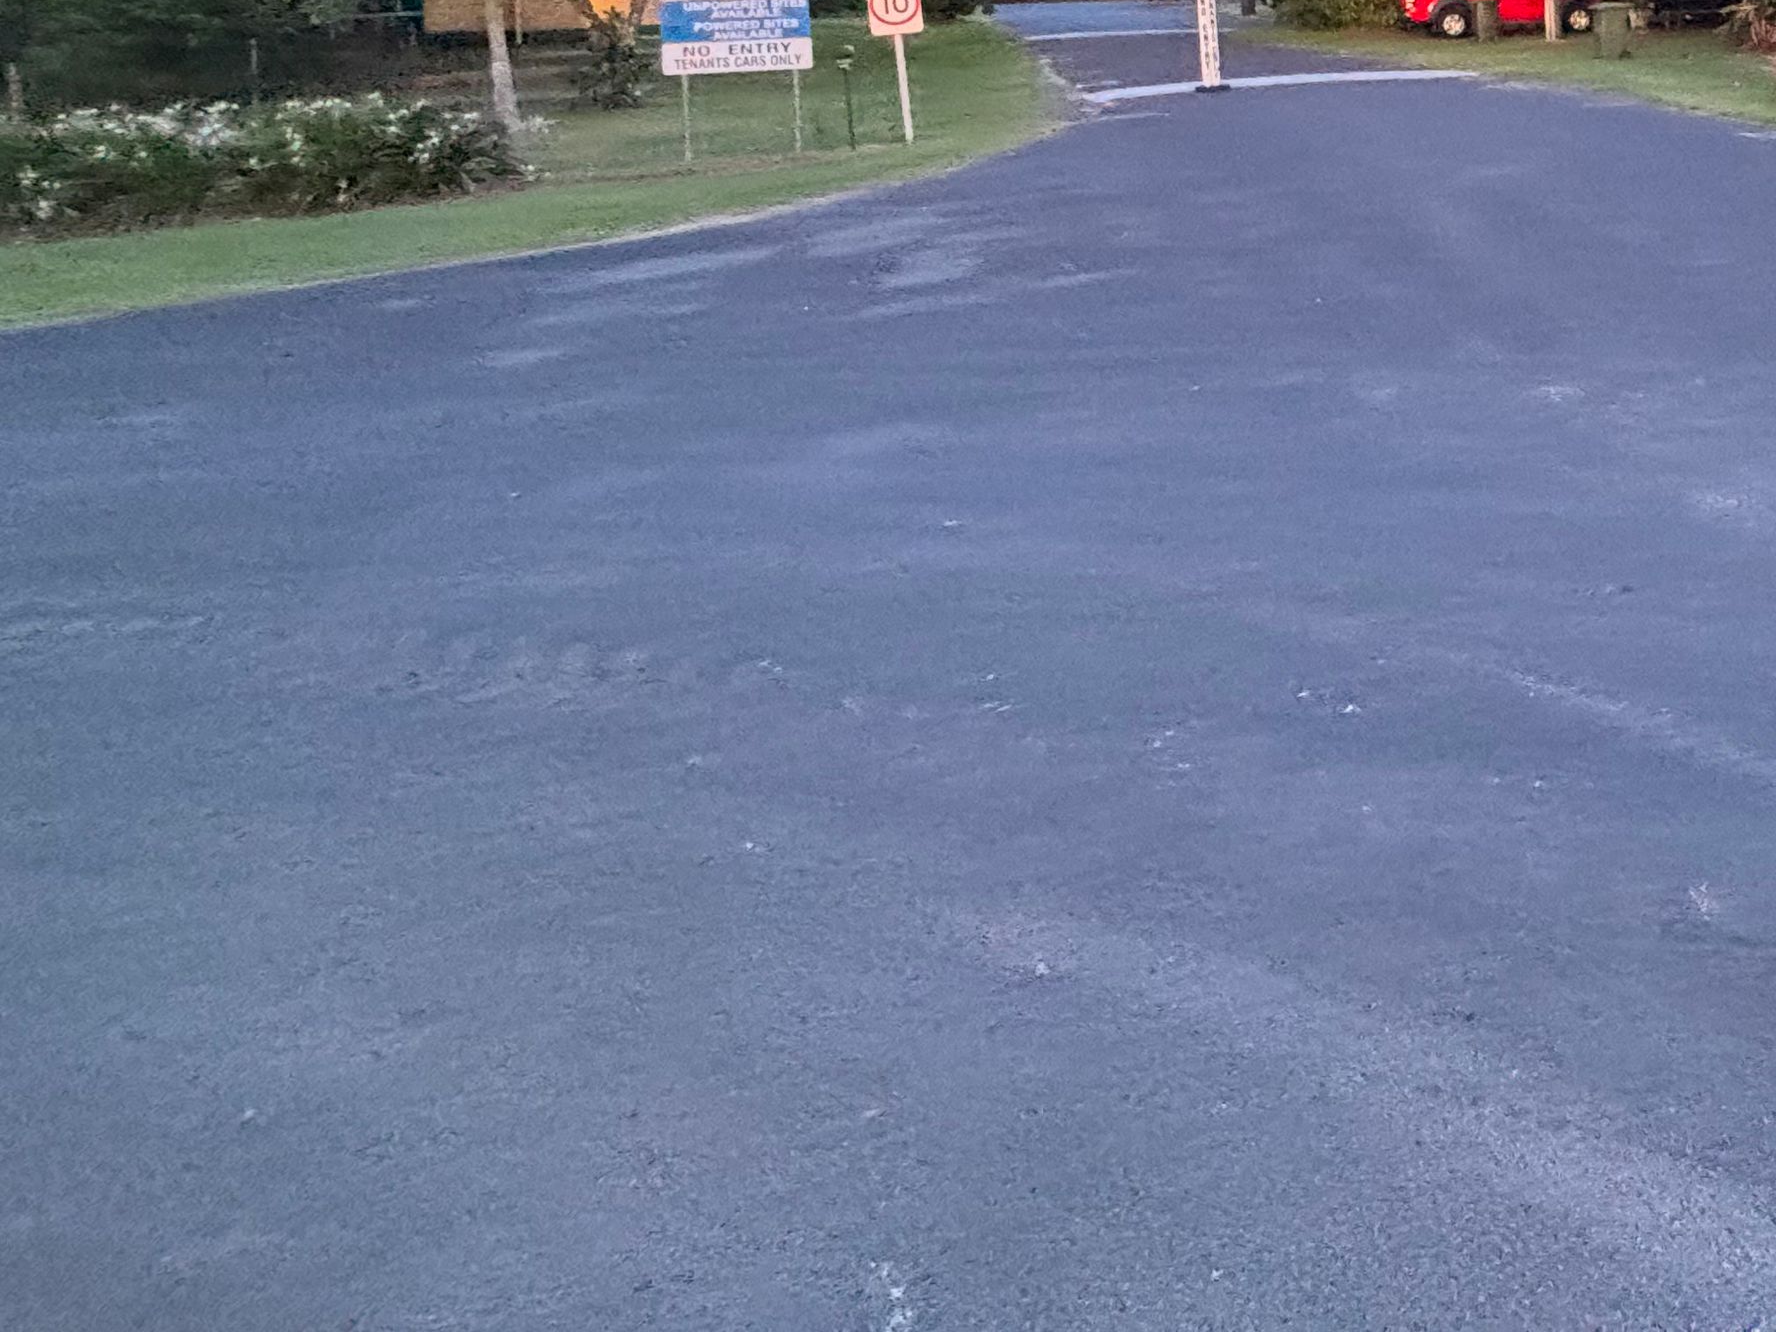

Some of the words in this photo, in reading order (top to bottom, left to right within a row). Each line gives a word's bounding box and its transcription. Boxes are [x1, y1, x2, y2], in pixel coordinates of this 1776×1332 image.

[711, 8, 782, 20] AVAILABLE
[692, 19, 761, 33] POWERED
[763, 18, 800, 29] SITES
[713, 29, 783, 41] AVAILABLE
[683, 45, 710, 57] NO
[728, 42, 791, 55] ENTRY
[675, 57, 730, 70] TENANTS
[734, 55, 766, 67] CARS
[770, 53, 801, 66] ONLY
